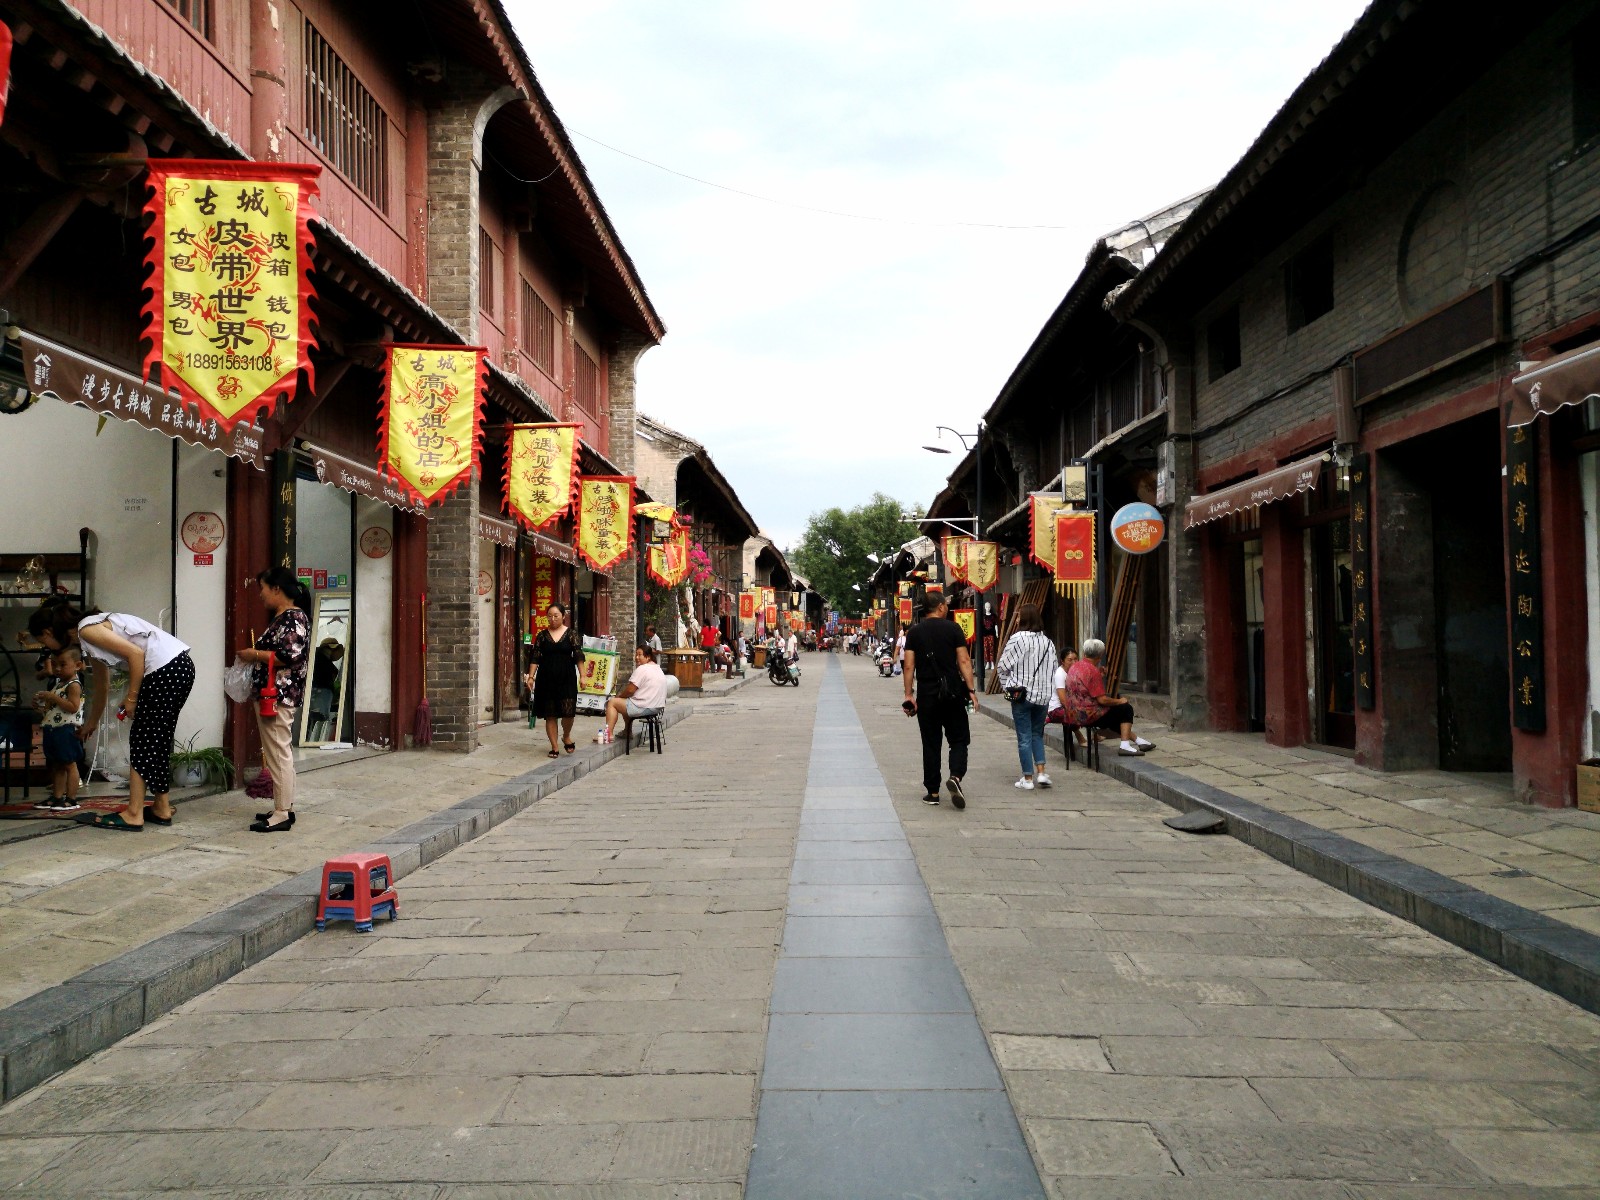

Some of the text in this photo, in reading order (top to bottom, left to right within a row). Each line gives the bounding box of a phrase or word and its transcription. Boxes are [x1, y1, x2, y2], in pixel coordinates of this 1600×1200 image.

[194, 185, 269, 218] 古城
[168, 227, 196, 336] 女包 男包
[209, 218, 255, 350] 皮带世界
[265, 231, 292, 341] 皮箱 钱包
[185, 352, 273, 372] 18891563108
[410, 353, 457, 373] 古城
[82, 373, 152, 420] 漫步古韩城
[415, 373, 448, 467] 高小姐的店
[530, 437, 552, 504] 遇见女装
[535, 557, 551, 581] 内衣
[535, 586, 551, 610] 袜子
